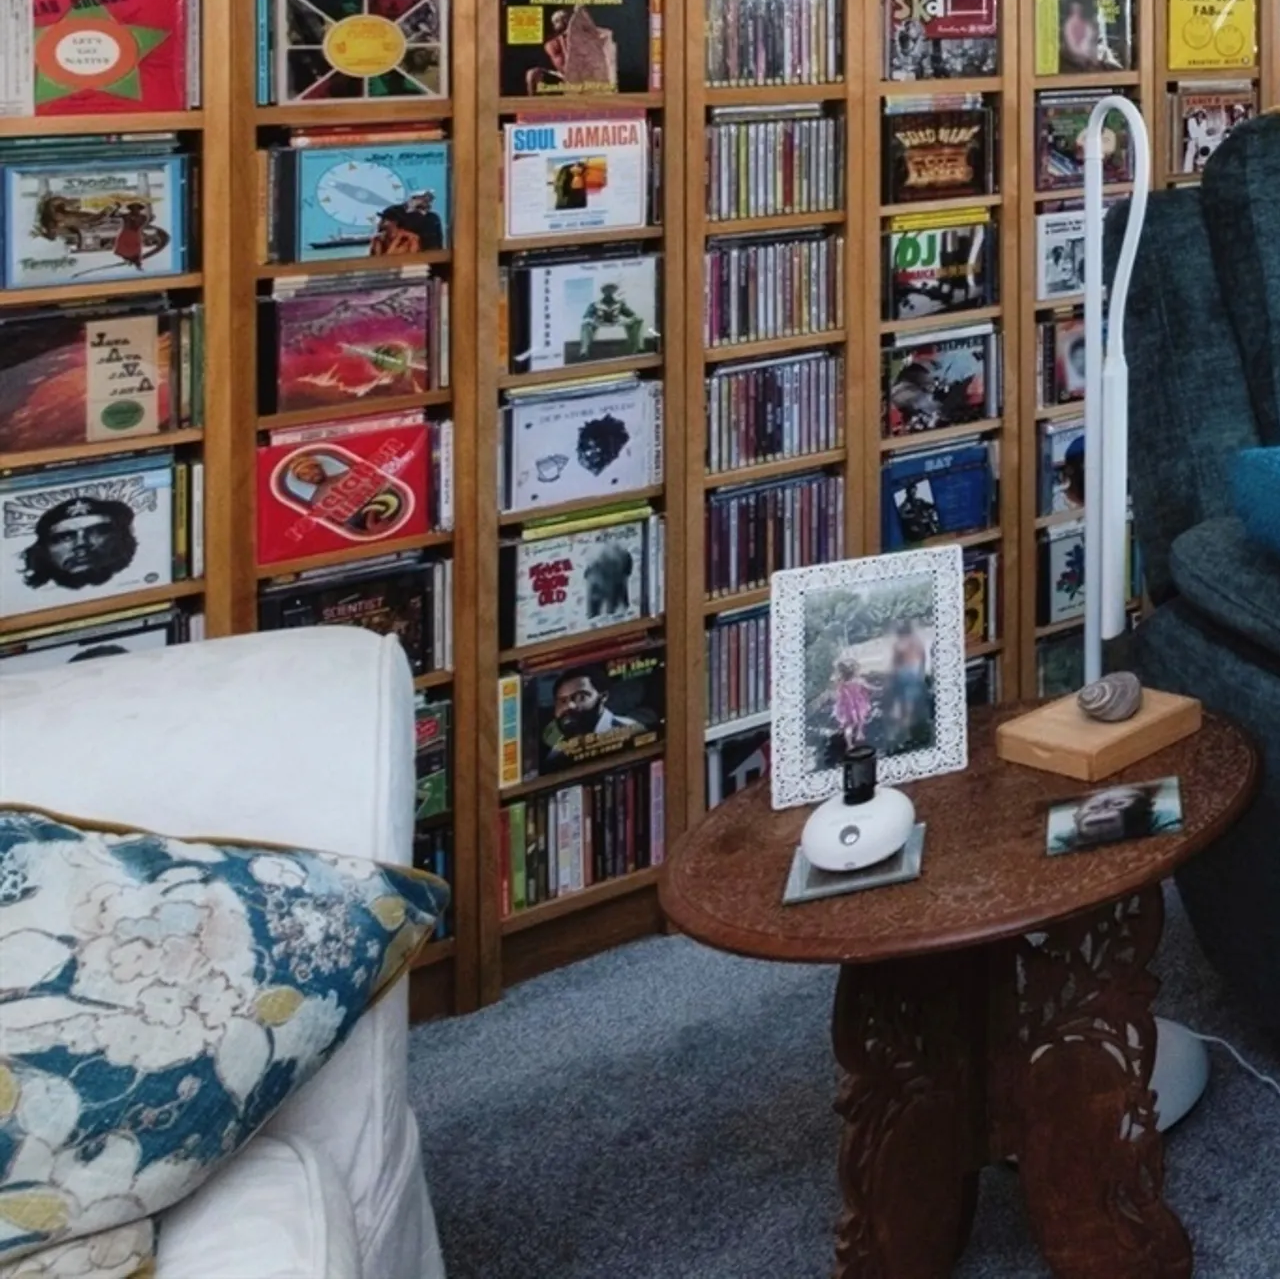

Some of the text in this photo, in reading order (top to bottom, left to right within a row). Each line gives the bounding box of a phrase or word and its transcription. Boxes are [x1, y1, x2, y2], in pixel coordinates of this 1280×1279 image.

[513, 123, 639, 152] SOUL JAMAICA
[20, 256, 79, 273] Temple
[322, 596, 386, 619] SCIENTIST
[538, 589, 568, 607] OLD
